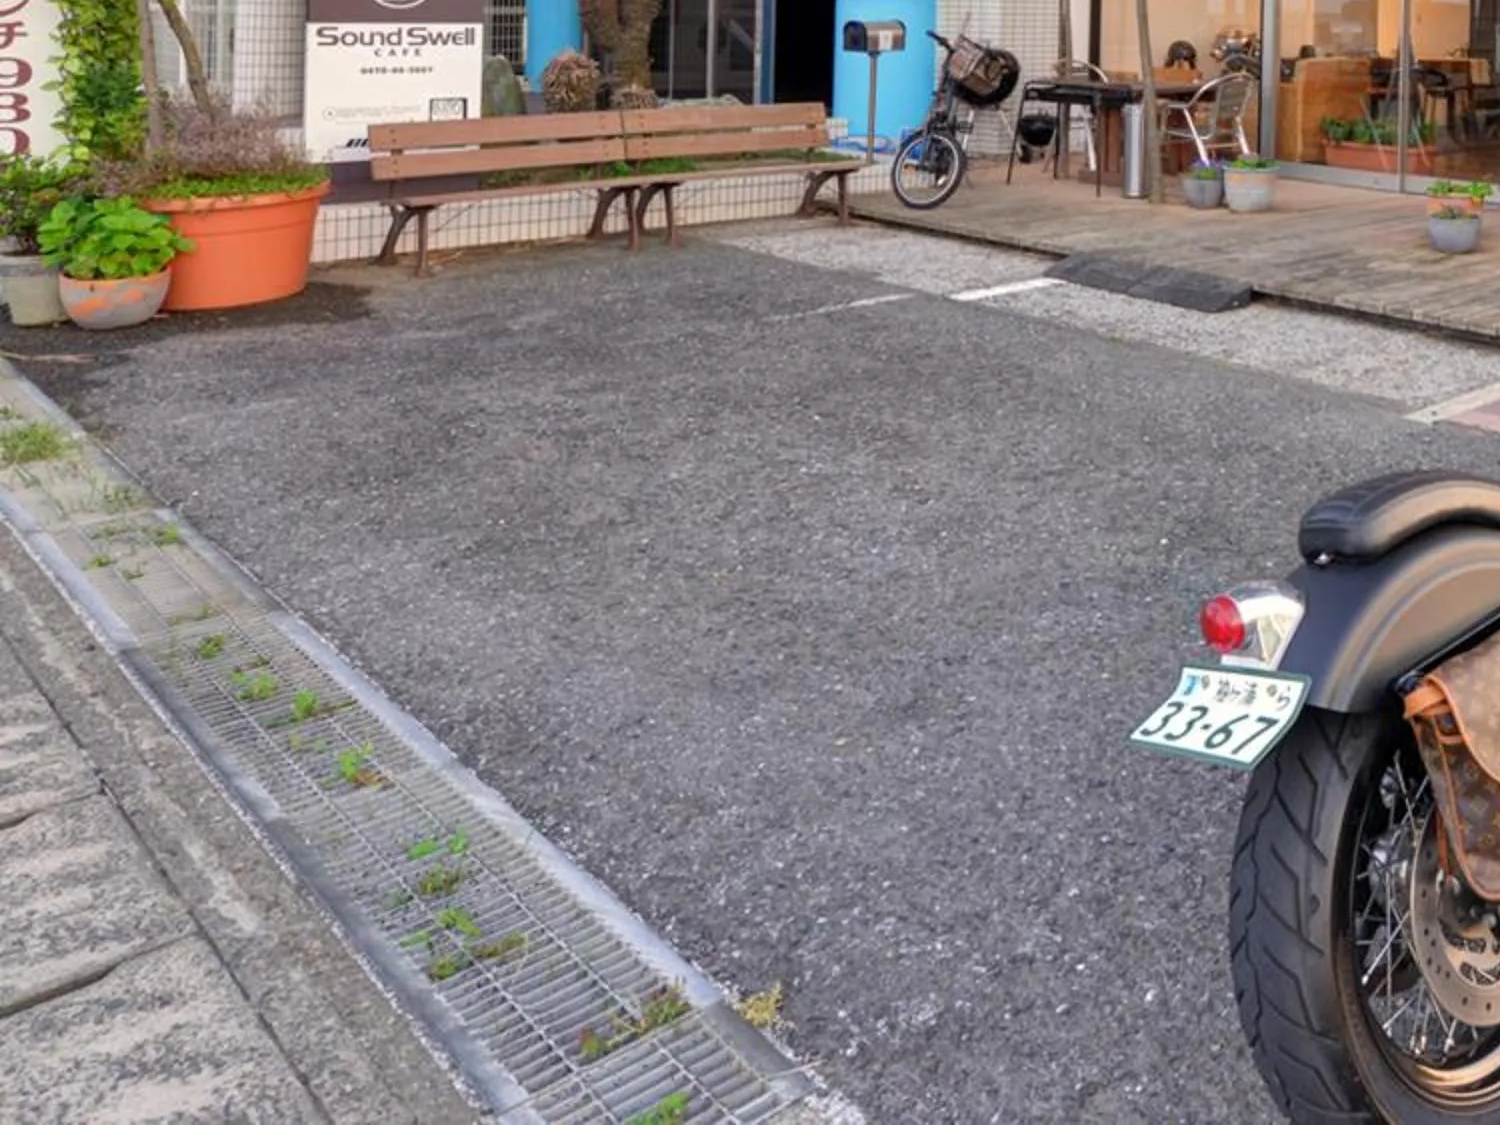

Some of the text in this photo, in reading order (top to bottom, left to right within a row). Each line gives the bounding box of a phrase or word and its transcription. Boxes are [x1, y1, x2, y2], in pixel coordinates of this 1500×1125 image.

[316, 26, 475, 47] Sound Swell
[373, 48, 422, 58] CAFE
[1139, 700, 1280, 756] 33-67
